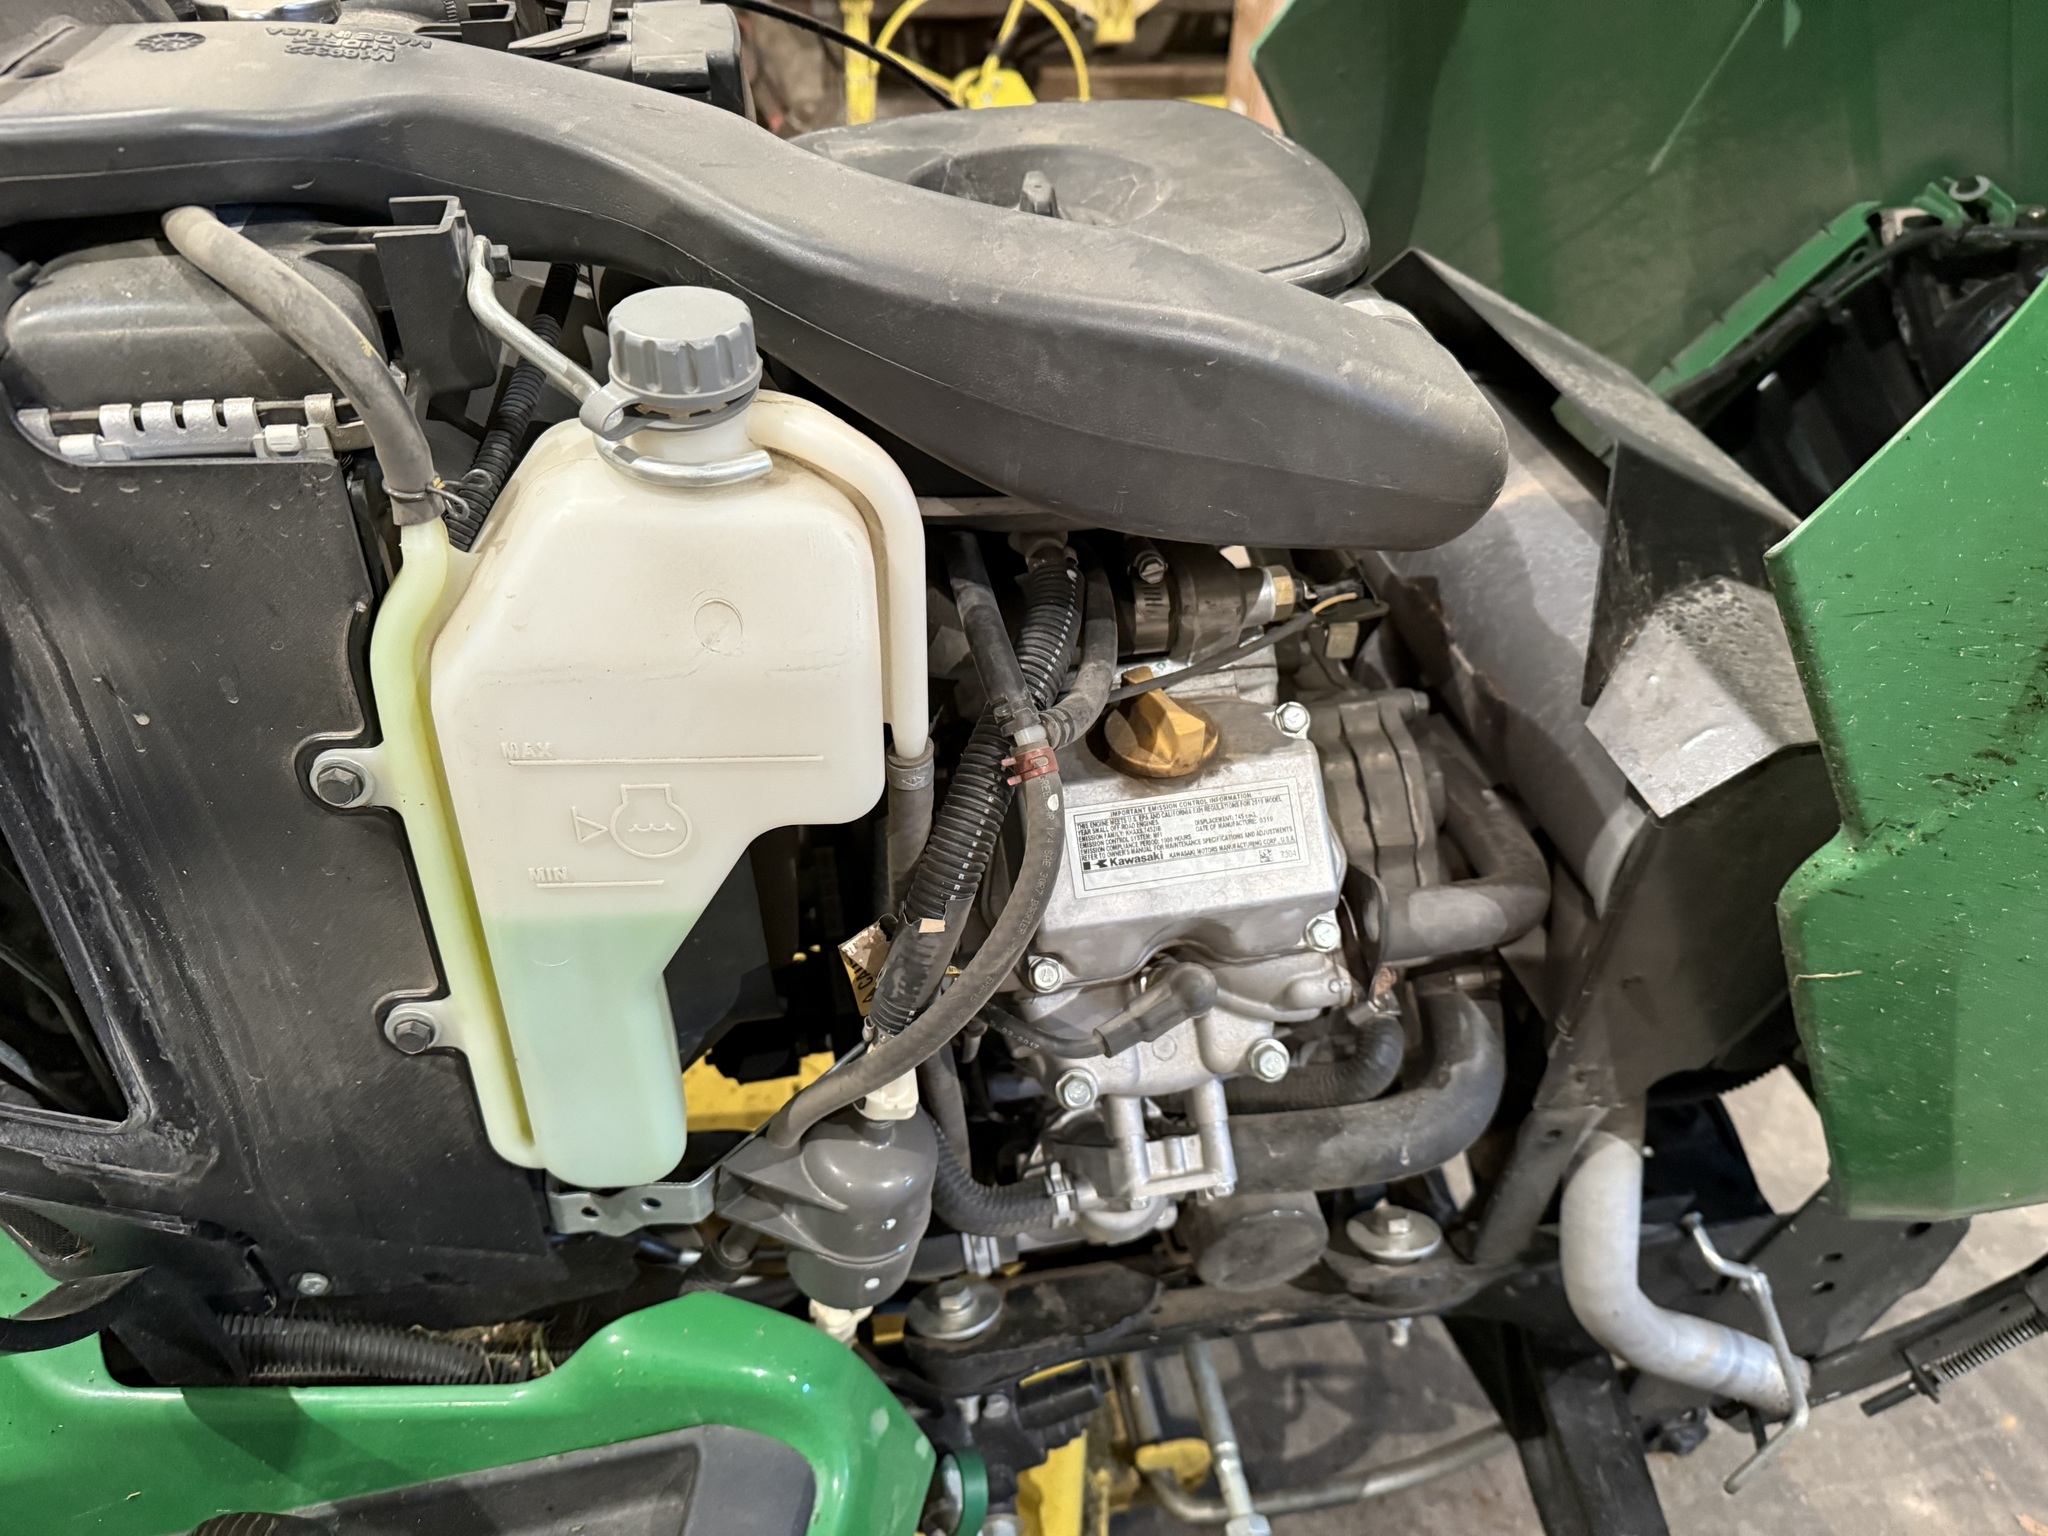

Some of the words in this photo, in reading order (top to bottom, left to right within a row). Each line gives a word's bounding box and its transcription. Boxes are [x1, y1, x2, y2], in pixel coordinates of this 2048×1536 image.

[266, 27, 319, 37] USA
[325, 30, 352, 39] IN
[356, 32, 433, 49] MADE
[500, 742, 553, 758] MAX
[1089, 819, 1108, 827] ENGINE
[1109, 817, 1127, 825] MEETS
[1161, 807, 1191, 817] CALIFORNIA
[1204, 801, 1238, 811] REGULATIONS
[1264, 795, 1281, 803] MODEL
[1110, 807, 1145, 816] IMPORTANT
[1147, 802, 1177, 811] EMISSION
[1178, 798, 1206, 807] CONTROL
[1209, 792, 1251, 802] INFORMATION
[1194, 815, 1233, 825] DISPLACEMENT:
[1217, 818, 1256, 828] MANUFACTURE:
[1078, 833, 1102, 842] EMISSION
[1079, 839, 1104, 848] EMISSION
[1105, 836, 1128, 844] CONTROL
[1080, 846, 1105, 855] EMISSION
[1105, 841, 1138, 851] COMPLIANCE
[1139, 838, 1159, 846] PERIOD:
[1081, 853, 1097, 861] REFER
[1164, 839, 1200, 849] MAINTENANCE
[1202, 833, 1243, 843] SPECIFICATIONS
[1169, 849, 1195, 858] KAWASAKI
[1197, 846, 1217, 854] MOTORS
[1218, 839, 1262, 851] MANUFACTURING
[1041, 850, 1054, 867] SAE
[1109, 850, 1163, 866] Kawasaki
[528, 867, 568, 881] MIN
[1034, 871, 1050, 896] 30R7
